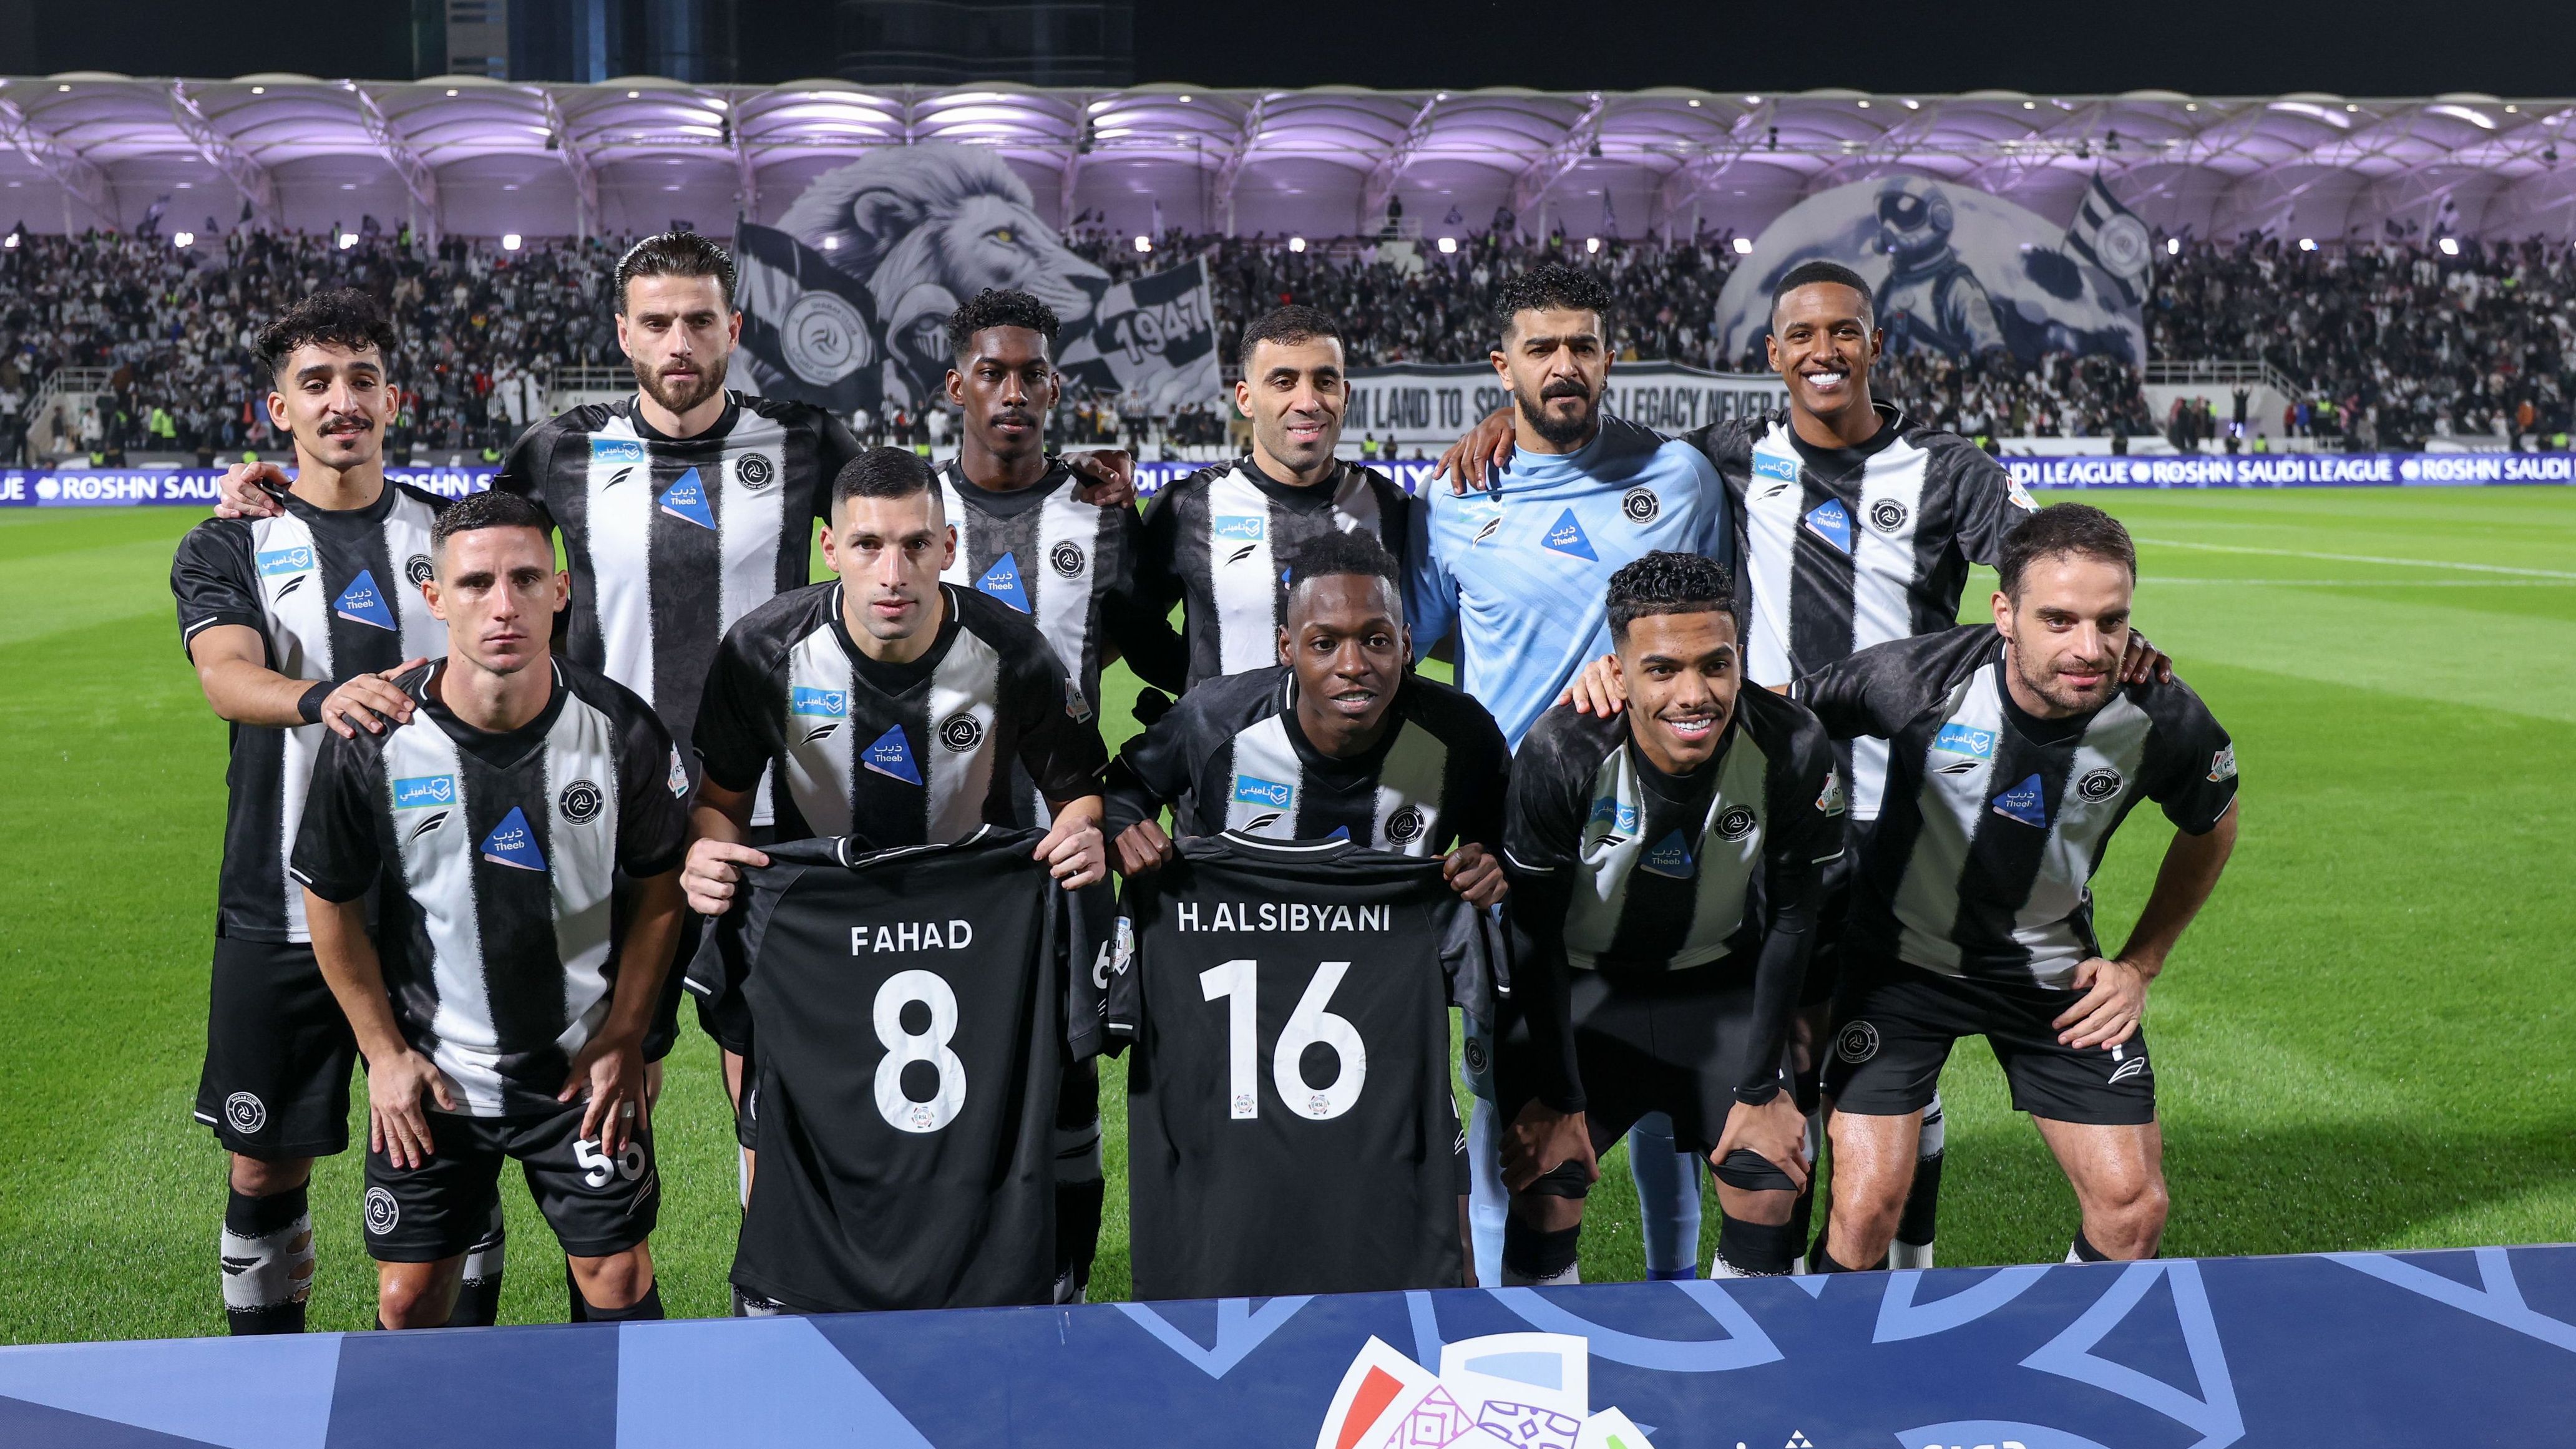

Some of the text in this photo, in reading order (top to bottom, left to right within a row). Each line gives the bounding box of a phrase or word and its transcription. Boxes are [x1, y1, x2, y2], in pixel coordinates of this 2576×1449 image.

[1114, 287, 1205, 364] 1947
[1375, 387, 1430, 428] LAND
[1437, 388, 1462, 429] TO
[1622, 386, 1702, 427] LEGACY
[1707, 389, 1772, 423] NEVER
[2042, 462, 2129, 484] LEAGUE
[2152, 461, 2232, 484] ROSHN
[2237, 460, 2306, 483] SAUDI
[2308, 459, 2393, 482] LEAGUE
[2421, 458, 2501, 481] ROSHN
[2504, 457, 2572, 480] SAUDI
[65, 476, 220, 499] ROSHN SAU
[670, 486, 696, 497] ذيب
[670, 497, 696, 505] Theeb
[1817, 517, 1841, 529] Theeb
[1551, 525, 1576, 538] ذيب
[1553, 535, 1578, 546] Theeb
[987, 571, 1012, 582] ذيب
[987, 582, 1013, 590] Theeb
[344, 588, 372, 600] ذيب
[346, 599, 374, 609] Theeb
[965, 715, 977, 724] CLUB
[874, 743, 902, 753] ذيب
[875, 753, 902, 762] Theeb
[675, 761, 683, 775] RS
[565, 783, 597, 794] SHABAB CLUB
[2007, 791, 2034, 800] ذيب
[2006, 799, 2032, 807] Theeb
[493, 827, 524, 841] ذيب
[494, 841, 525, 851] Theeb
[1178, 902, 1390, 932] H.ALSIBYANI
[851, 919, 973, 956] FAHAD
[1111, 939, 1123, 950] SL
[1199, 959, 1367, 1120] 16
[872, 969, 967, 1133] 8
[246, 1097, 257, 1105] CLUB
[381, 1193, 391, 1203] CLUB
